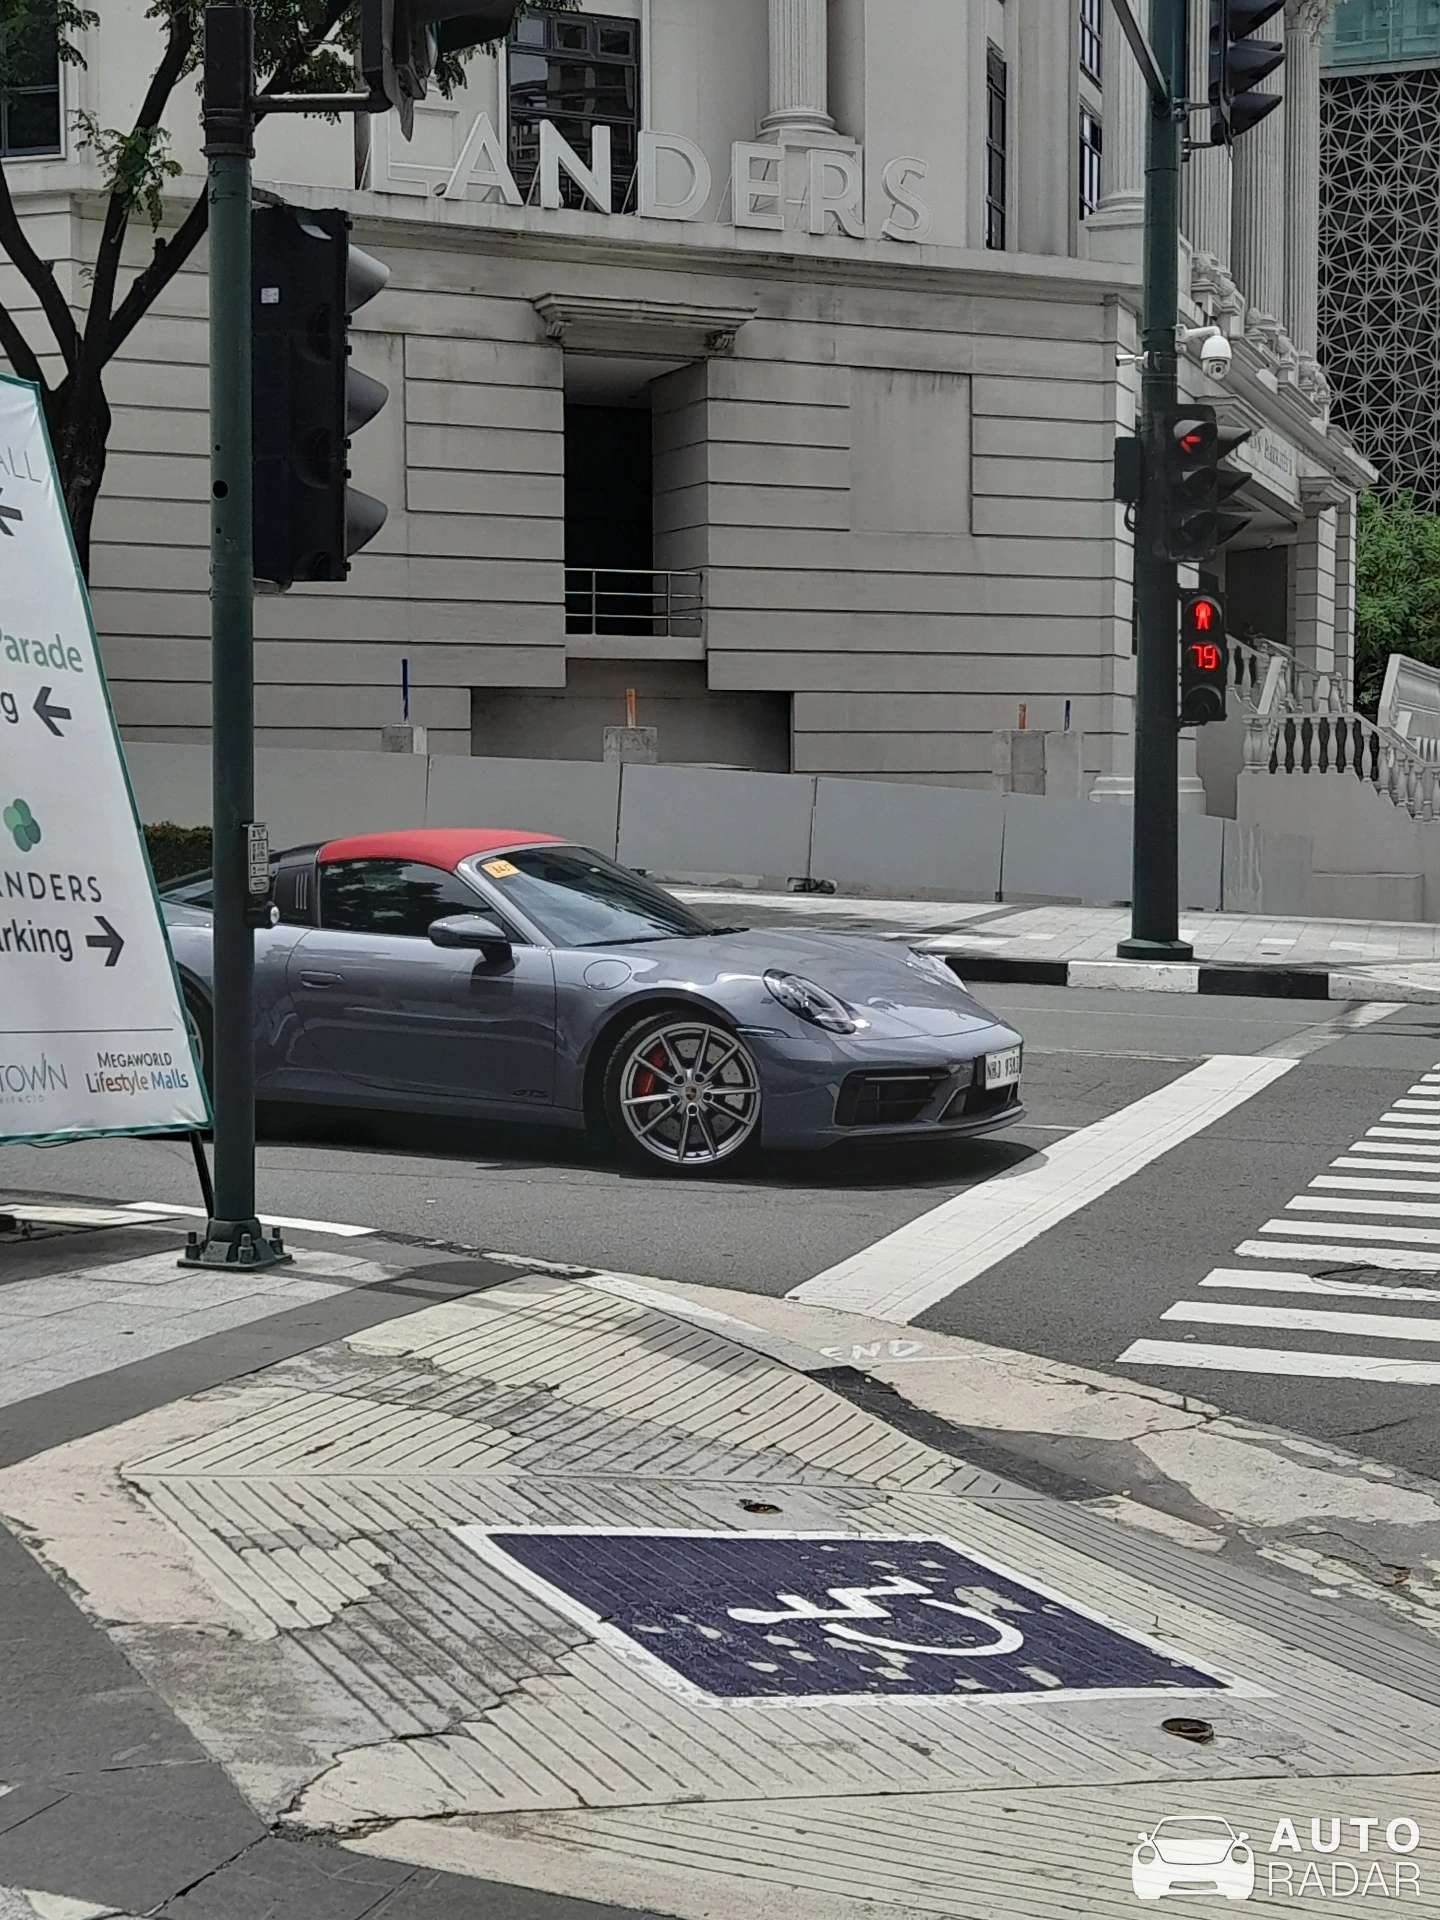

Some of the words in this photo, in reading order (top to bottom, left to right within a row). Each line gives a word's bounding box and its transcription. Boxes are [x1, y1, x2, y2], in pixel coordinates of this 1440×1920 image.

[370, 110, 933, 243] LANDERS
[0, 627, 84, 673] arade
[1191, 643, 1217, 669] 79
[0, 871, 102, 903] NDERS
[0, 918, 74, 962] rking
[97, 1052, 172, 1069] MEGAWORLD
[85, 1071, 149, 1096] Lifestyle
[150, 1068, 190, 1091] Malls
